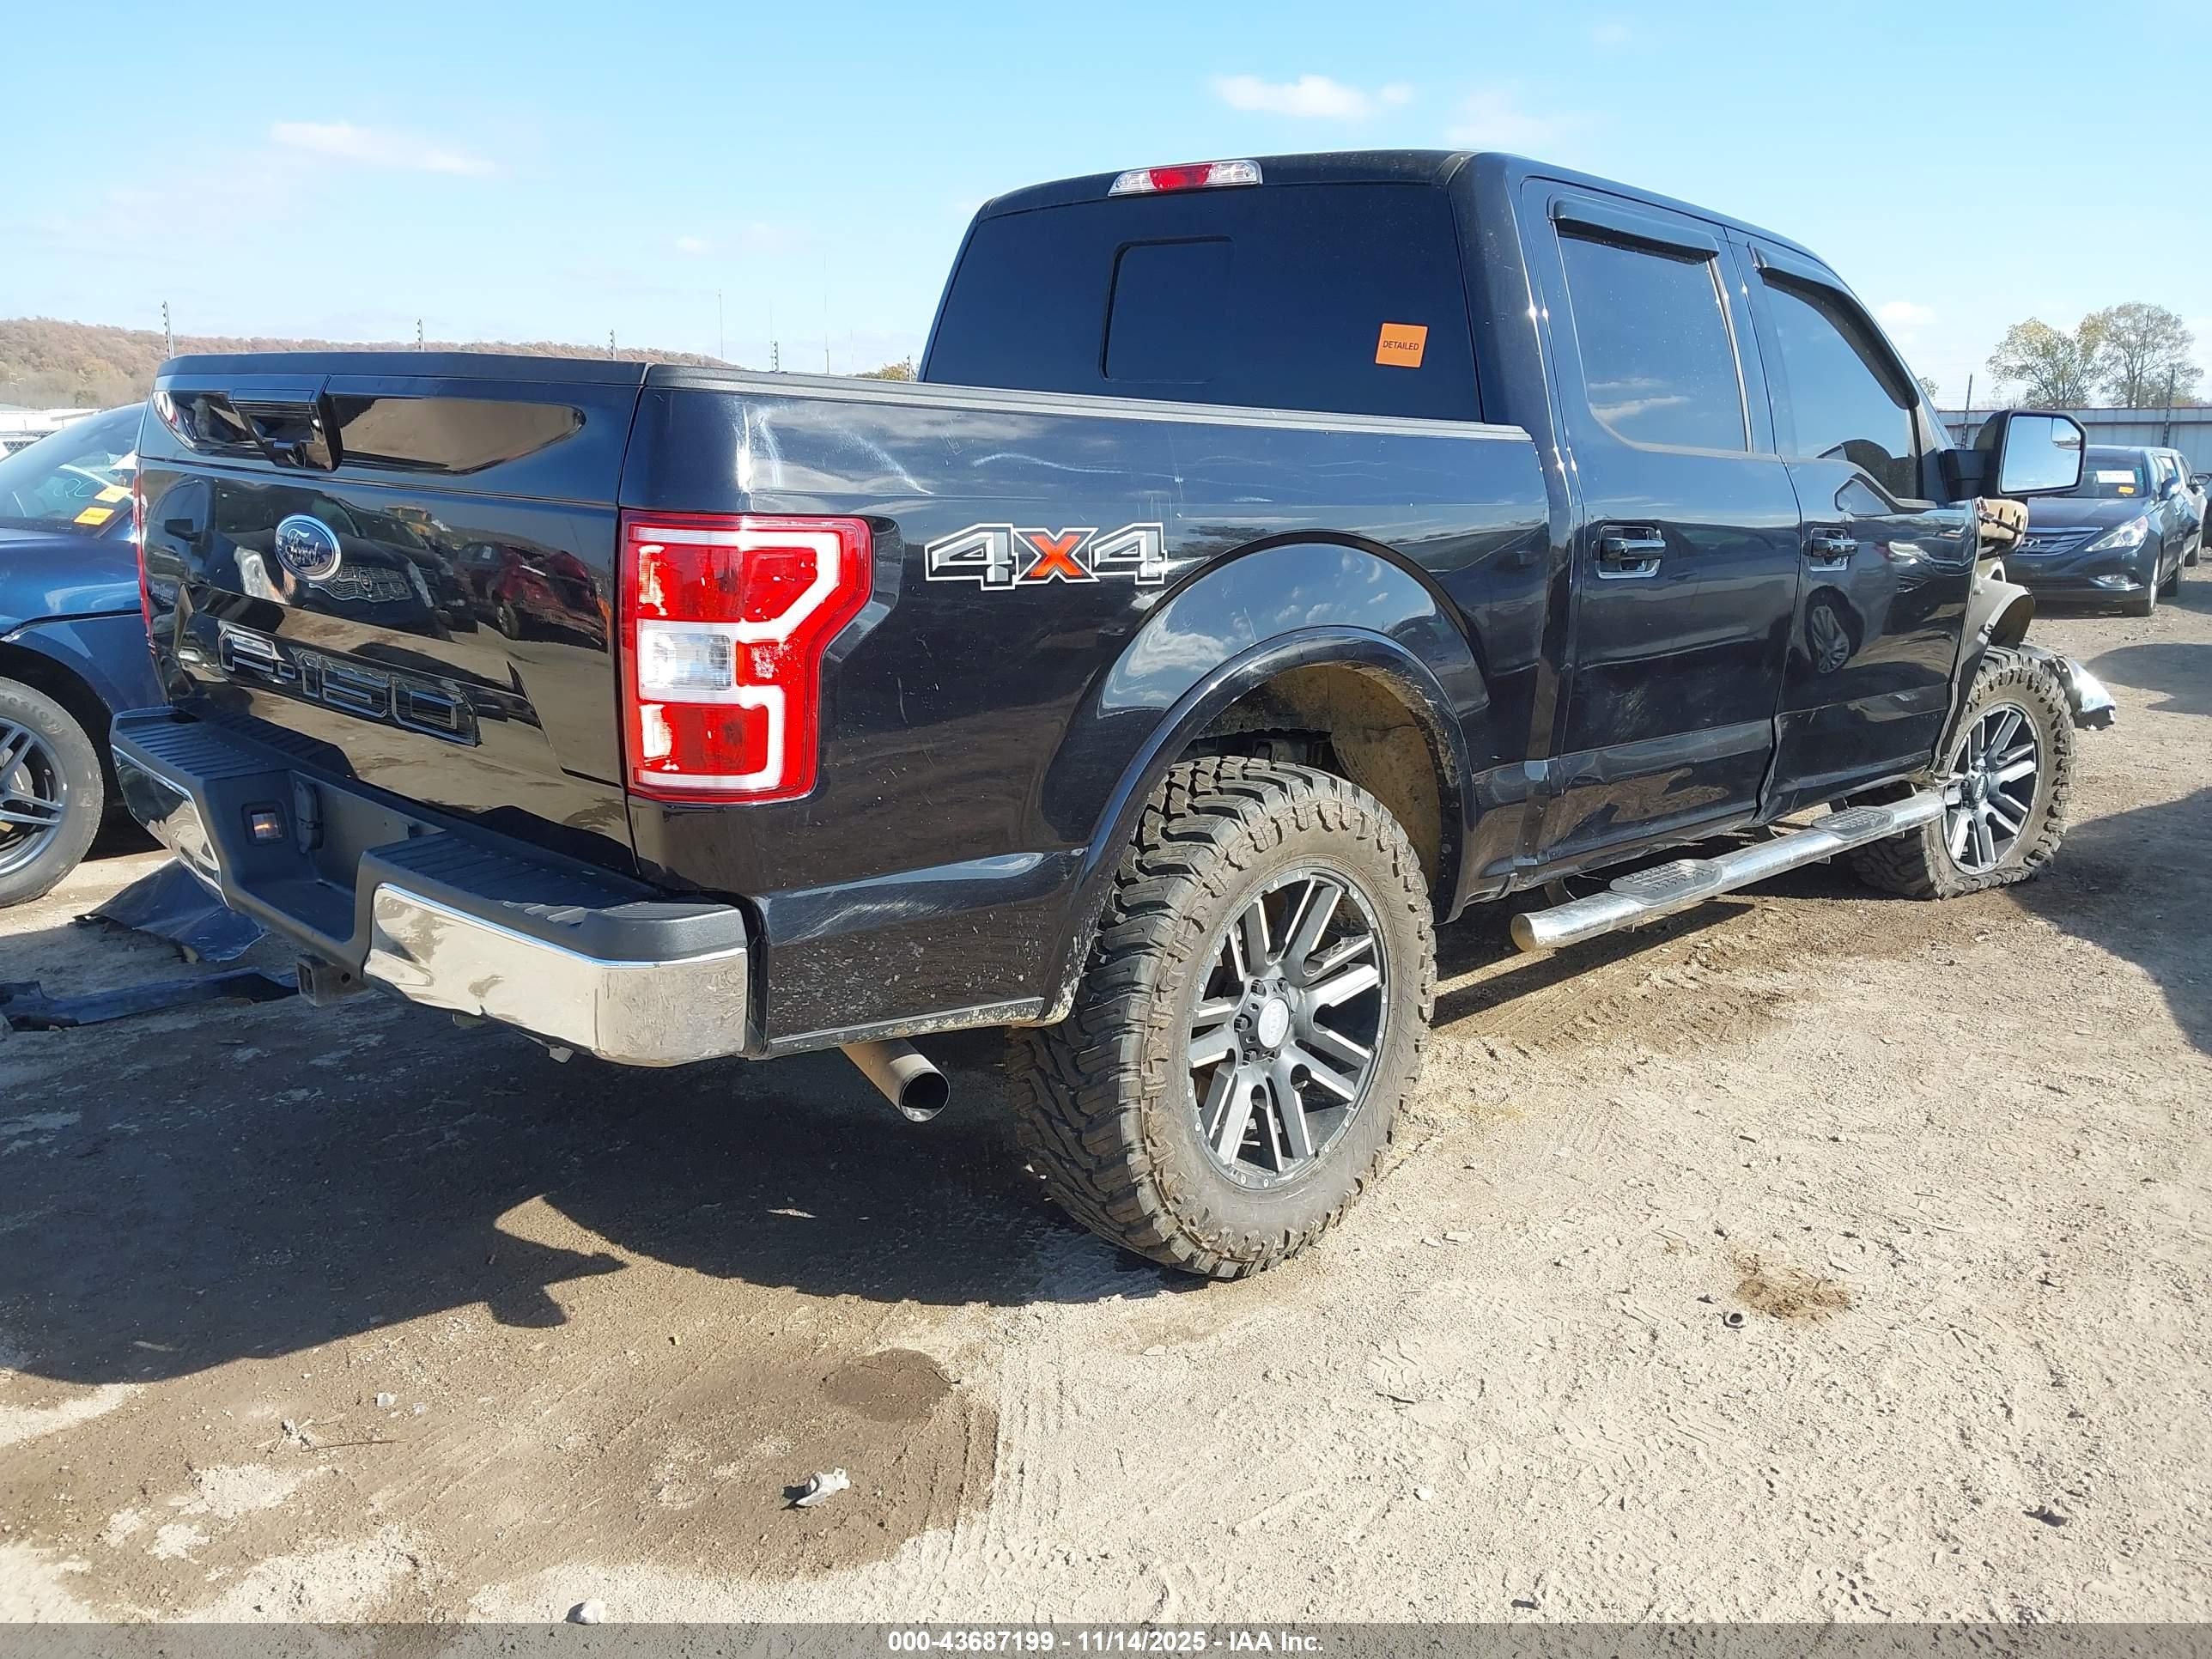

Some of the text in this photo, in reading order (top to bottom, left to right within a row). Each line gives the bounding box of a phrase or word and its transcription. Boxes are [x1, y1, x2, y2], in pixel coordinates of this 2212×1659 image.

[1382, 340, 1419, 350] DETAILED
[285, 528, 320, 567] Ford
[218, 622, 481, 747] F-150
